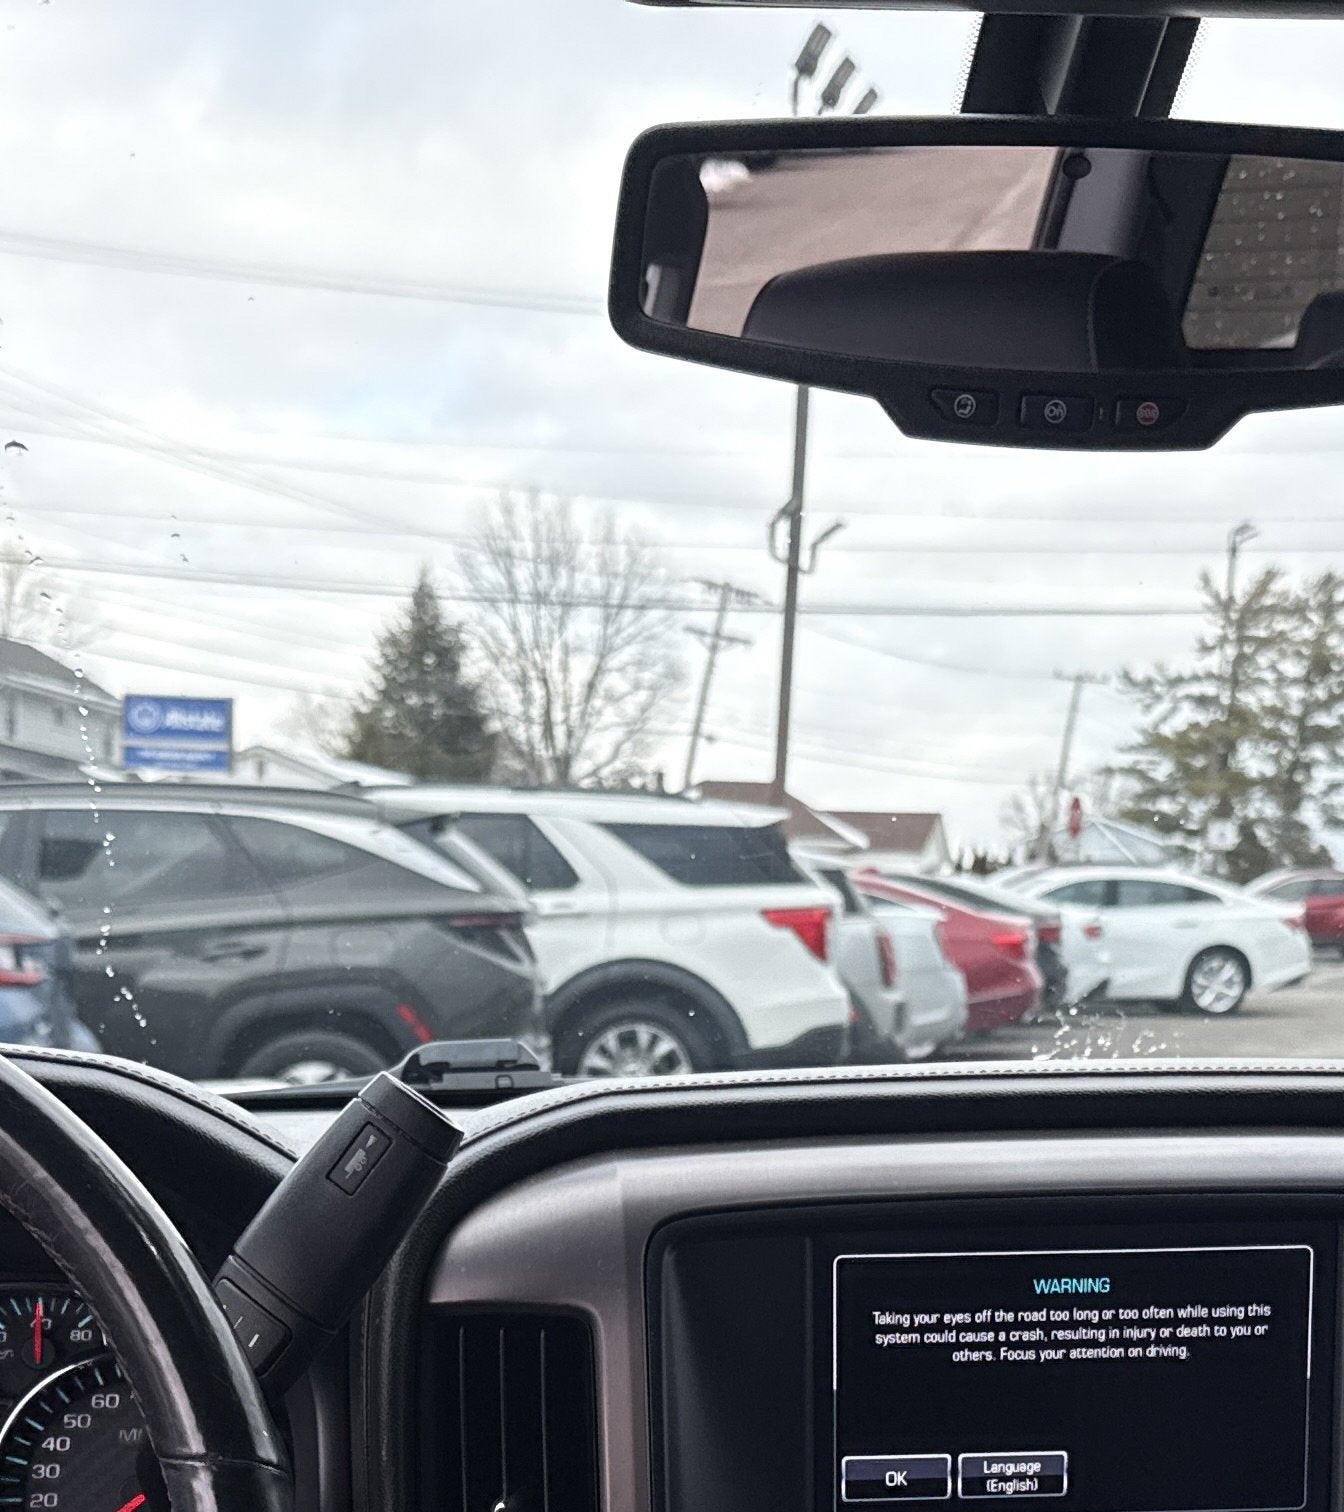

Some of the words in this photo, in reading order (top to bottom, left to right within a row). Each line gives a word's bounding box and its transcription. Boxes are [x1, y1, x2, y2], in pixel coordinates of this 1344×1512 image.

[1033, 1277, 1111, 1294] WARNING
[872, 1311, 910, 1327] Taking
[913, 1313, 940, 1327] your
[943, 1312, 971, 1326] eyes
[975, 1309, 992, 1323] off
[995, 1308, 1014, 1322] the
[1018, 1308, 1046, 1322] road
[1050, 1310, 1069, 1321] too
[1073, 1307, 1099, 1323] long
[1102, 1310, 1115, 1320] or
[1119, 1308, 1138, 1320] too
[1142, 1305, 1174, 1319] often
[1177, 1304, 1208, 1318] while
[1211, 1304, 1244, 1320] using
[1247, 1303, 1271, 1317] this
[70, 1329, 92, 1342] 80
[875, 1332, 920, 1347] system
[924, 1329, 956, 1343] could
[959, 1331, 995, 1342] cause
[998, 1331, 1005, 1342] a
[1009, 1328, 1047, 1342] crash,
[1051, 1327, 1106, 1342] resulting
[1109, 1326, 1120, 1339] in
[1123, 1325, 1156, 1341] injury
[1159, 1327, 1173, 1338] or
[1176, 1324, 1210, 1338] death
[1214, 1325, 1227, 1336] to
[1230, 1325, 1251, 1339] you
[1254, 1324, 1268, 1335] or
[952, 1348, 996, 1362] others.
[1000, 1347, 1036, 1360] Focus
[1039, 1349, 1066, 1362] your
[1069, 1345, 1124, 1359] attention
[1128, 1347, 1142, 1358] on
[1145, 1344, 1190, 1360] driving.
[91, 1393, 120, 1409] 60
[63, 1413, 92, 1429] 50
[42, 1436, 71, 1452] 40
[31, 1464, 61, 1479] 30
[983, 1461, 1041, 1476] Language
[885, 1471, 908, 1487] OK
[986, 1478, 1038, 1494] (English)
[29, 1492, 58, 1508] 20
